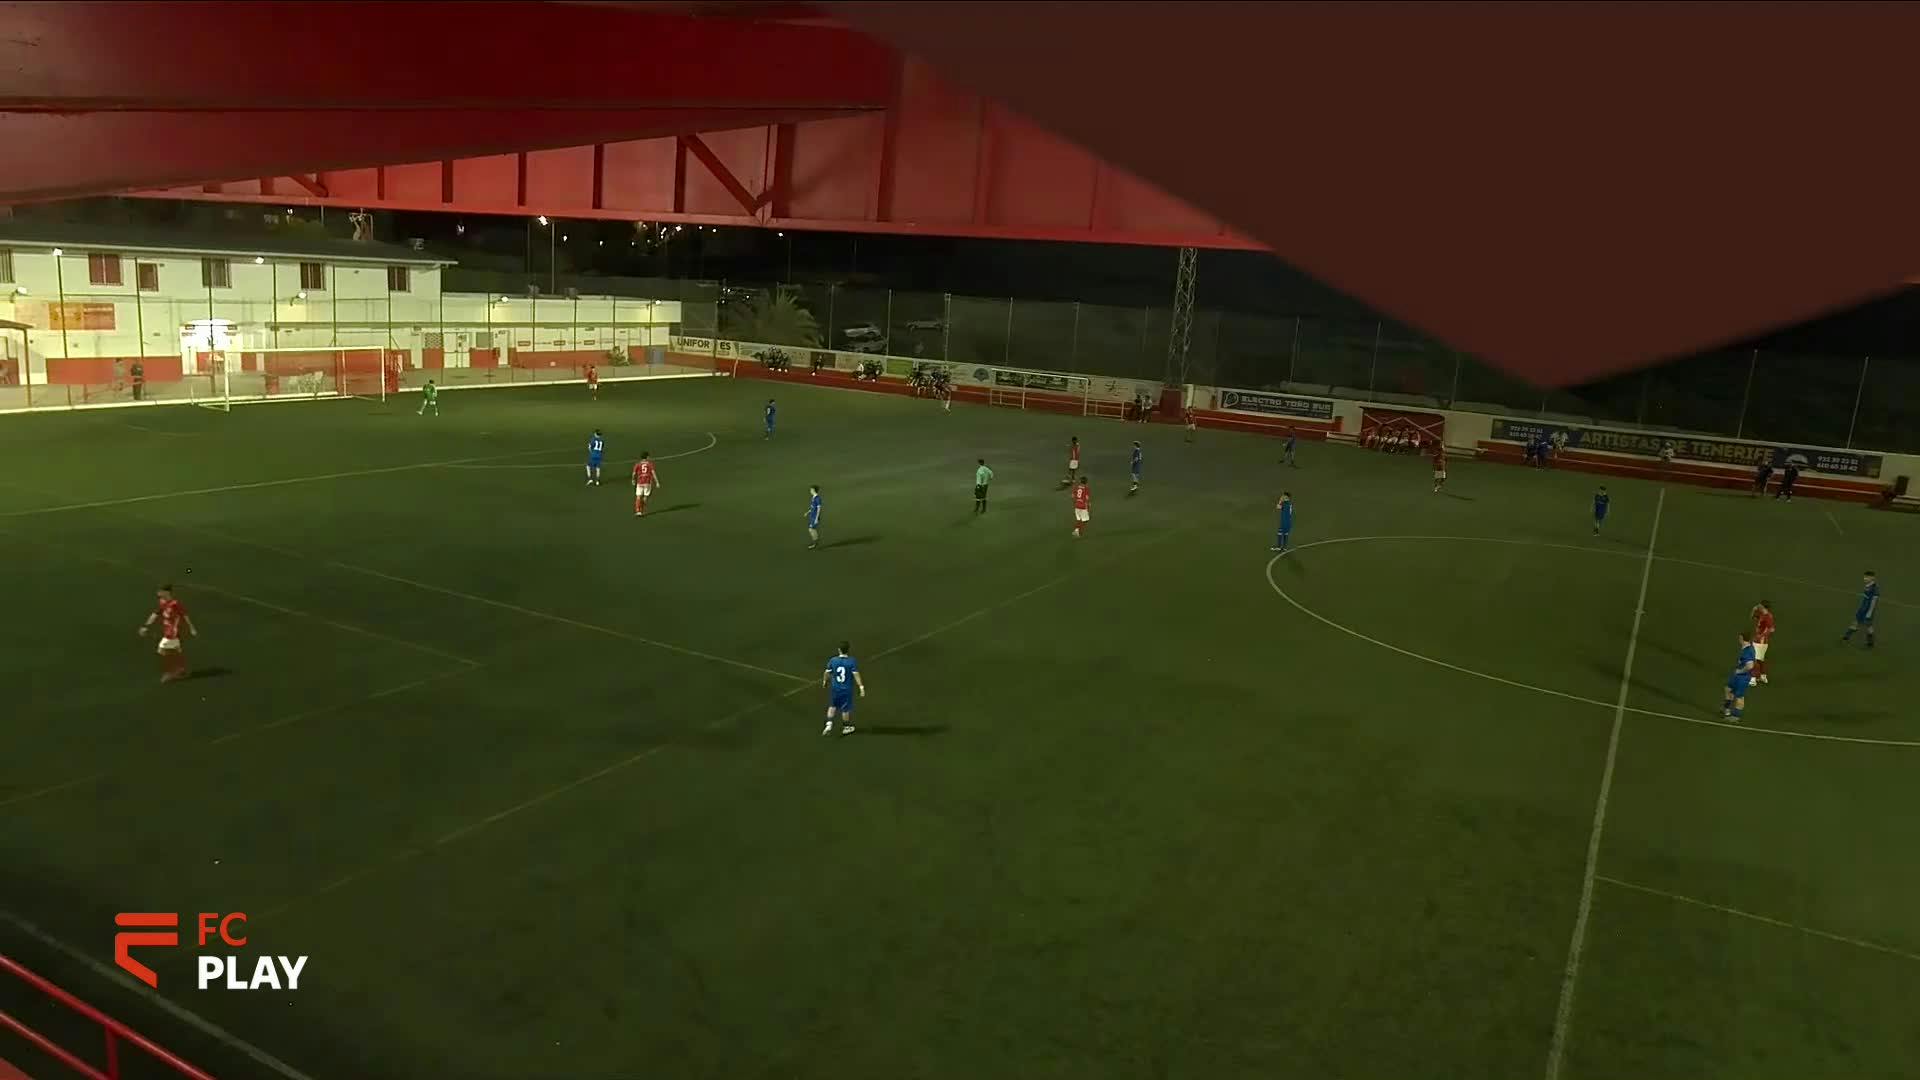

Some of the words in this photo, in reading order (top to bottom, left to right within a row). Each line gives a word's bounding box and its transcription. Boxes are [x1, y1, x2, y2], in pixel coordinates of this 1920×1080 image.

[593, 440, 603, 451] 11
[1580, 431, 1661, 452] ARTISTAS
[1691, 441, 1774, 464] TENERIFE
[836, 666, 846, 683] 3
